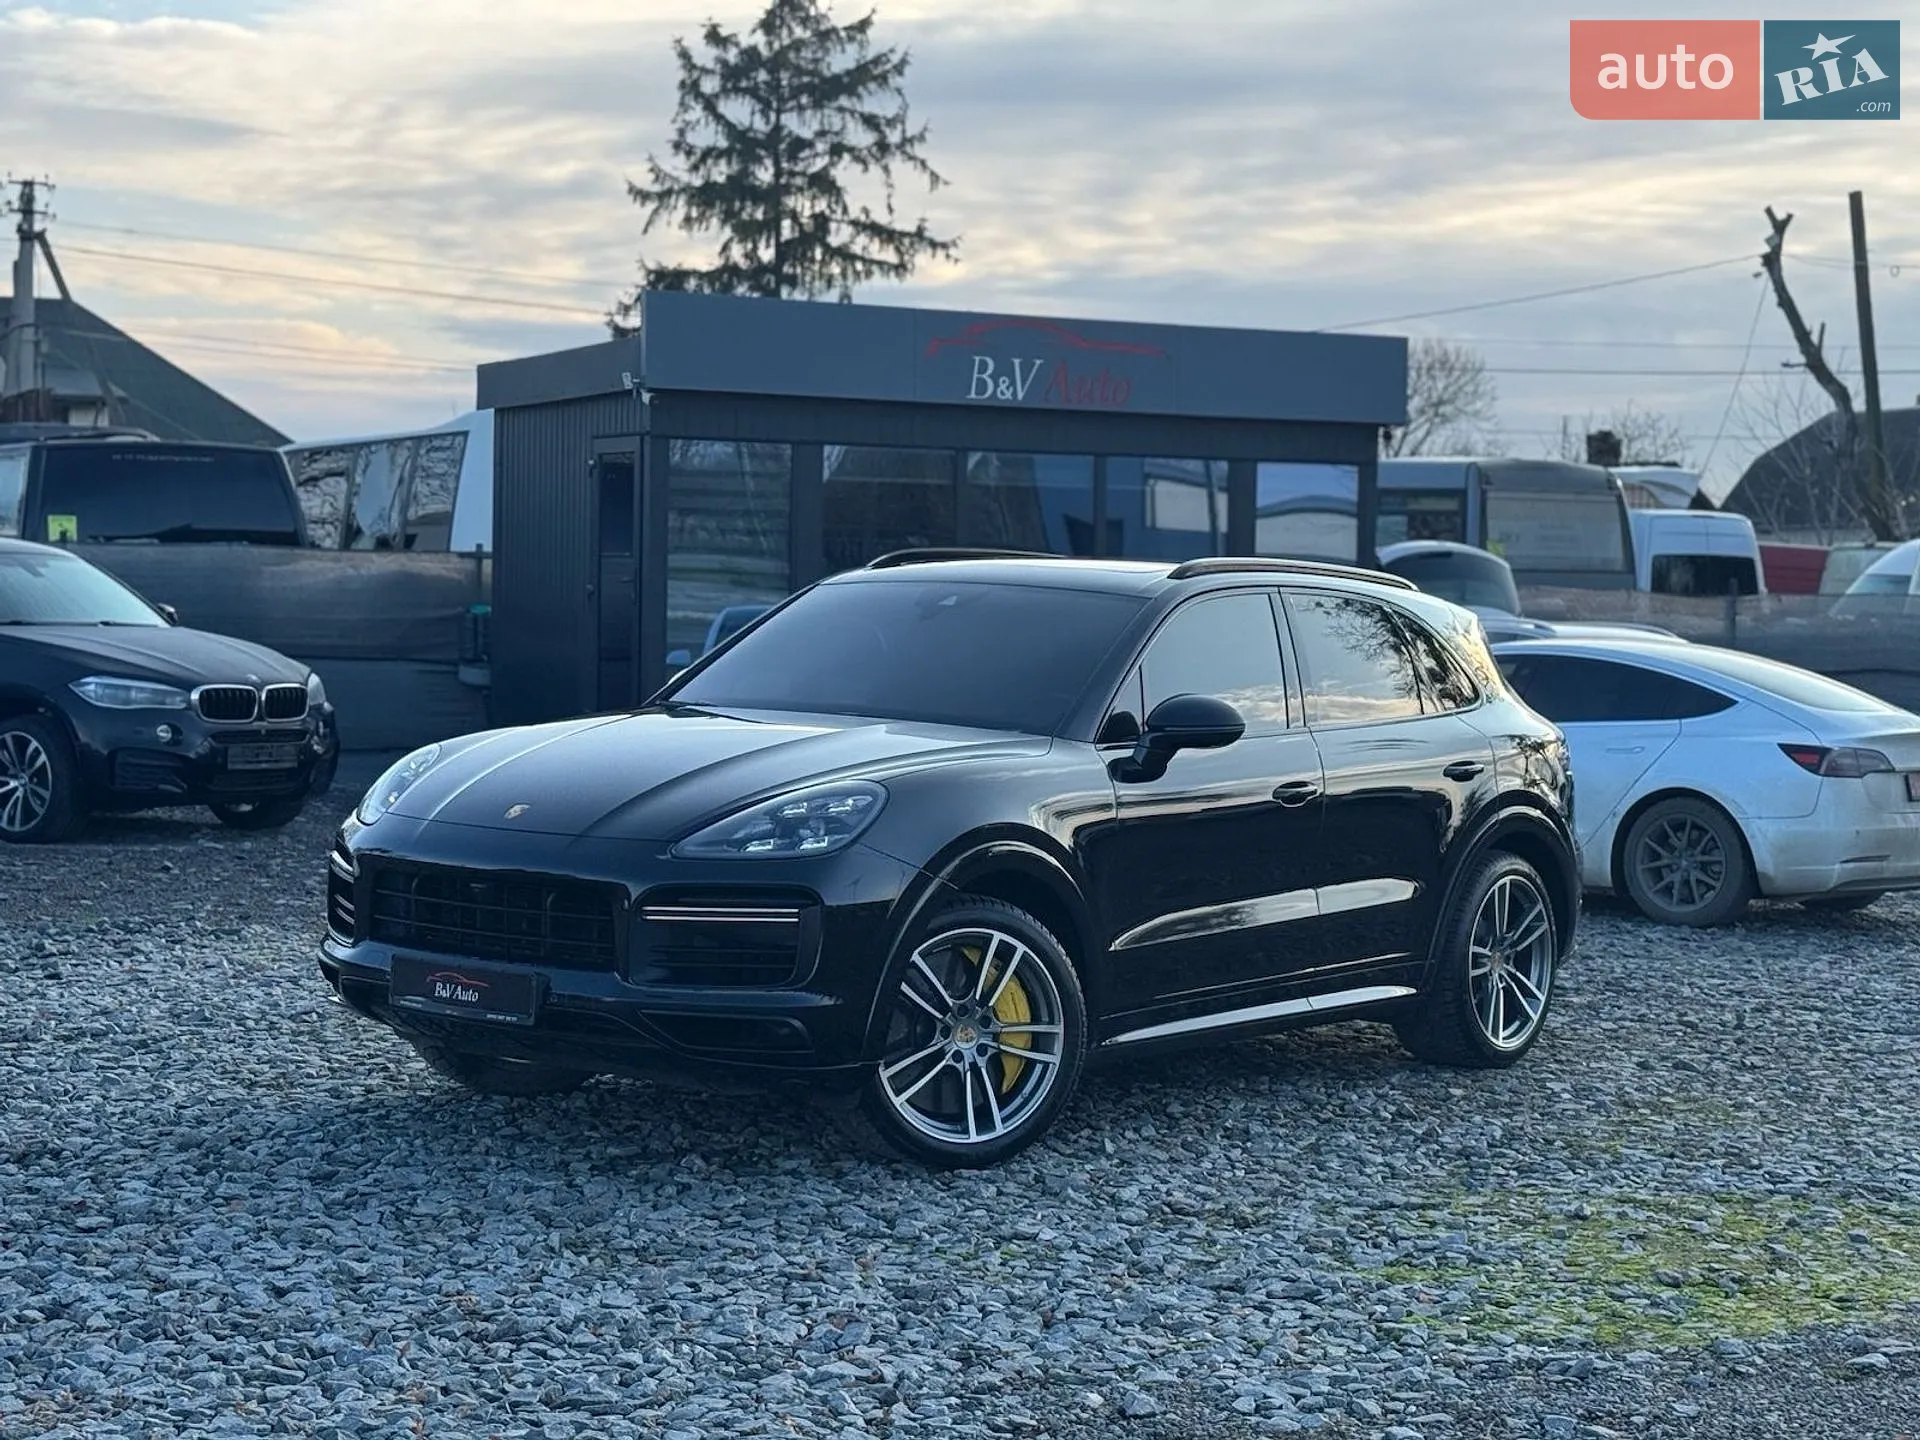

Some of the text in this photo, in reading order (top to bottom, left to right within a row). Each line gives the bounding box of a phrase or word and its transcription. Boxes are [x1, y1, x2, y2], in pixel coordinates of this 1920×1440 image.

[966, 355, 1131, 406] B&V Auto
[453, 985, 478, 1001] Auto
